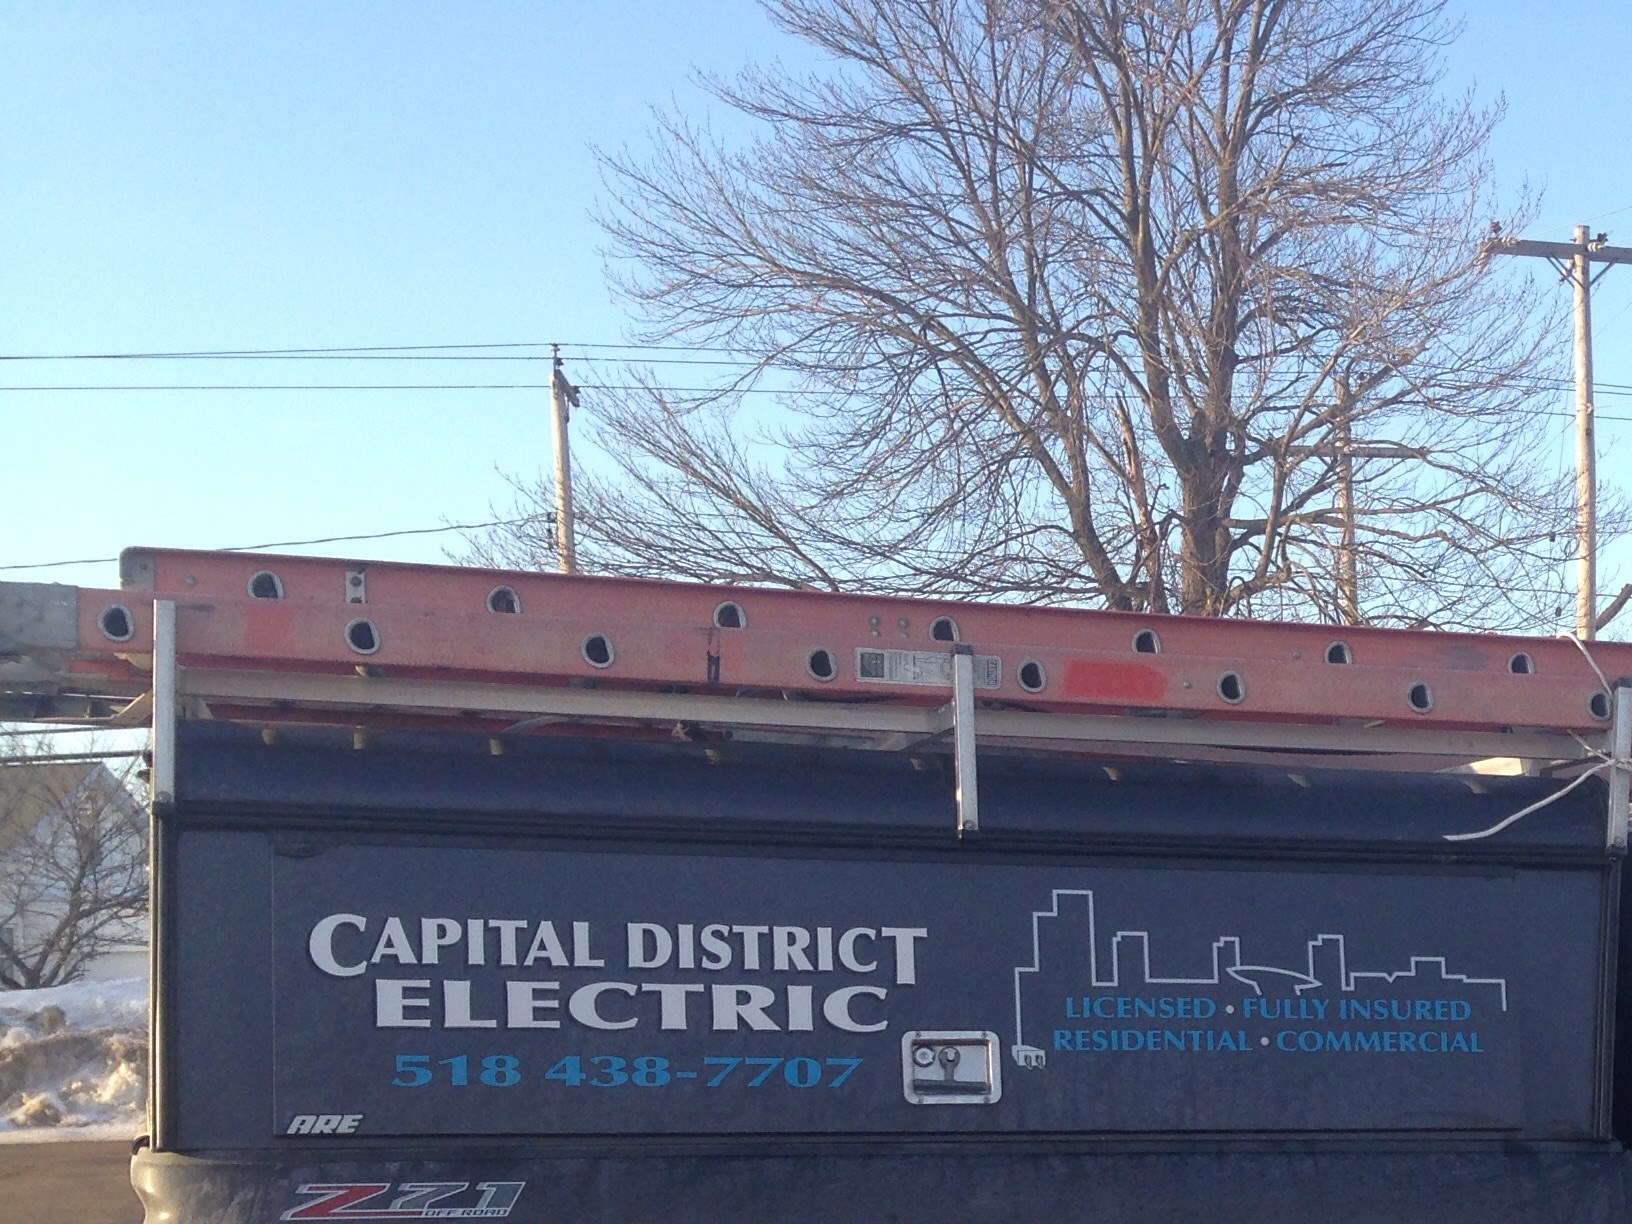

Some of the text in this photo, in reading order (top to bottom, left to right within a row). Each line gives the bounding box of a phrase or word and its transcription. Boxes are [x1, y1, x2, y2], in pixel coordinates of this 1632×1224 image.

[308, 913, 928, 985] CAPITAL DISTRICT
[375, 978, 889, 1032] ELECTRIC
[1065, 997, 1472, 1021] LICENSED FULLY INSURED
[1053, 1029, 1485, 1053] RESIDENTIAL COMMERCIAL
[391, 1054, 864, 1089] 518 438-7707
[286, 1114, 364, 1135] ARE
[279, 1181, 527, 1220] Z71
[424, 1208, 508, 1217] OFF ROAD
